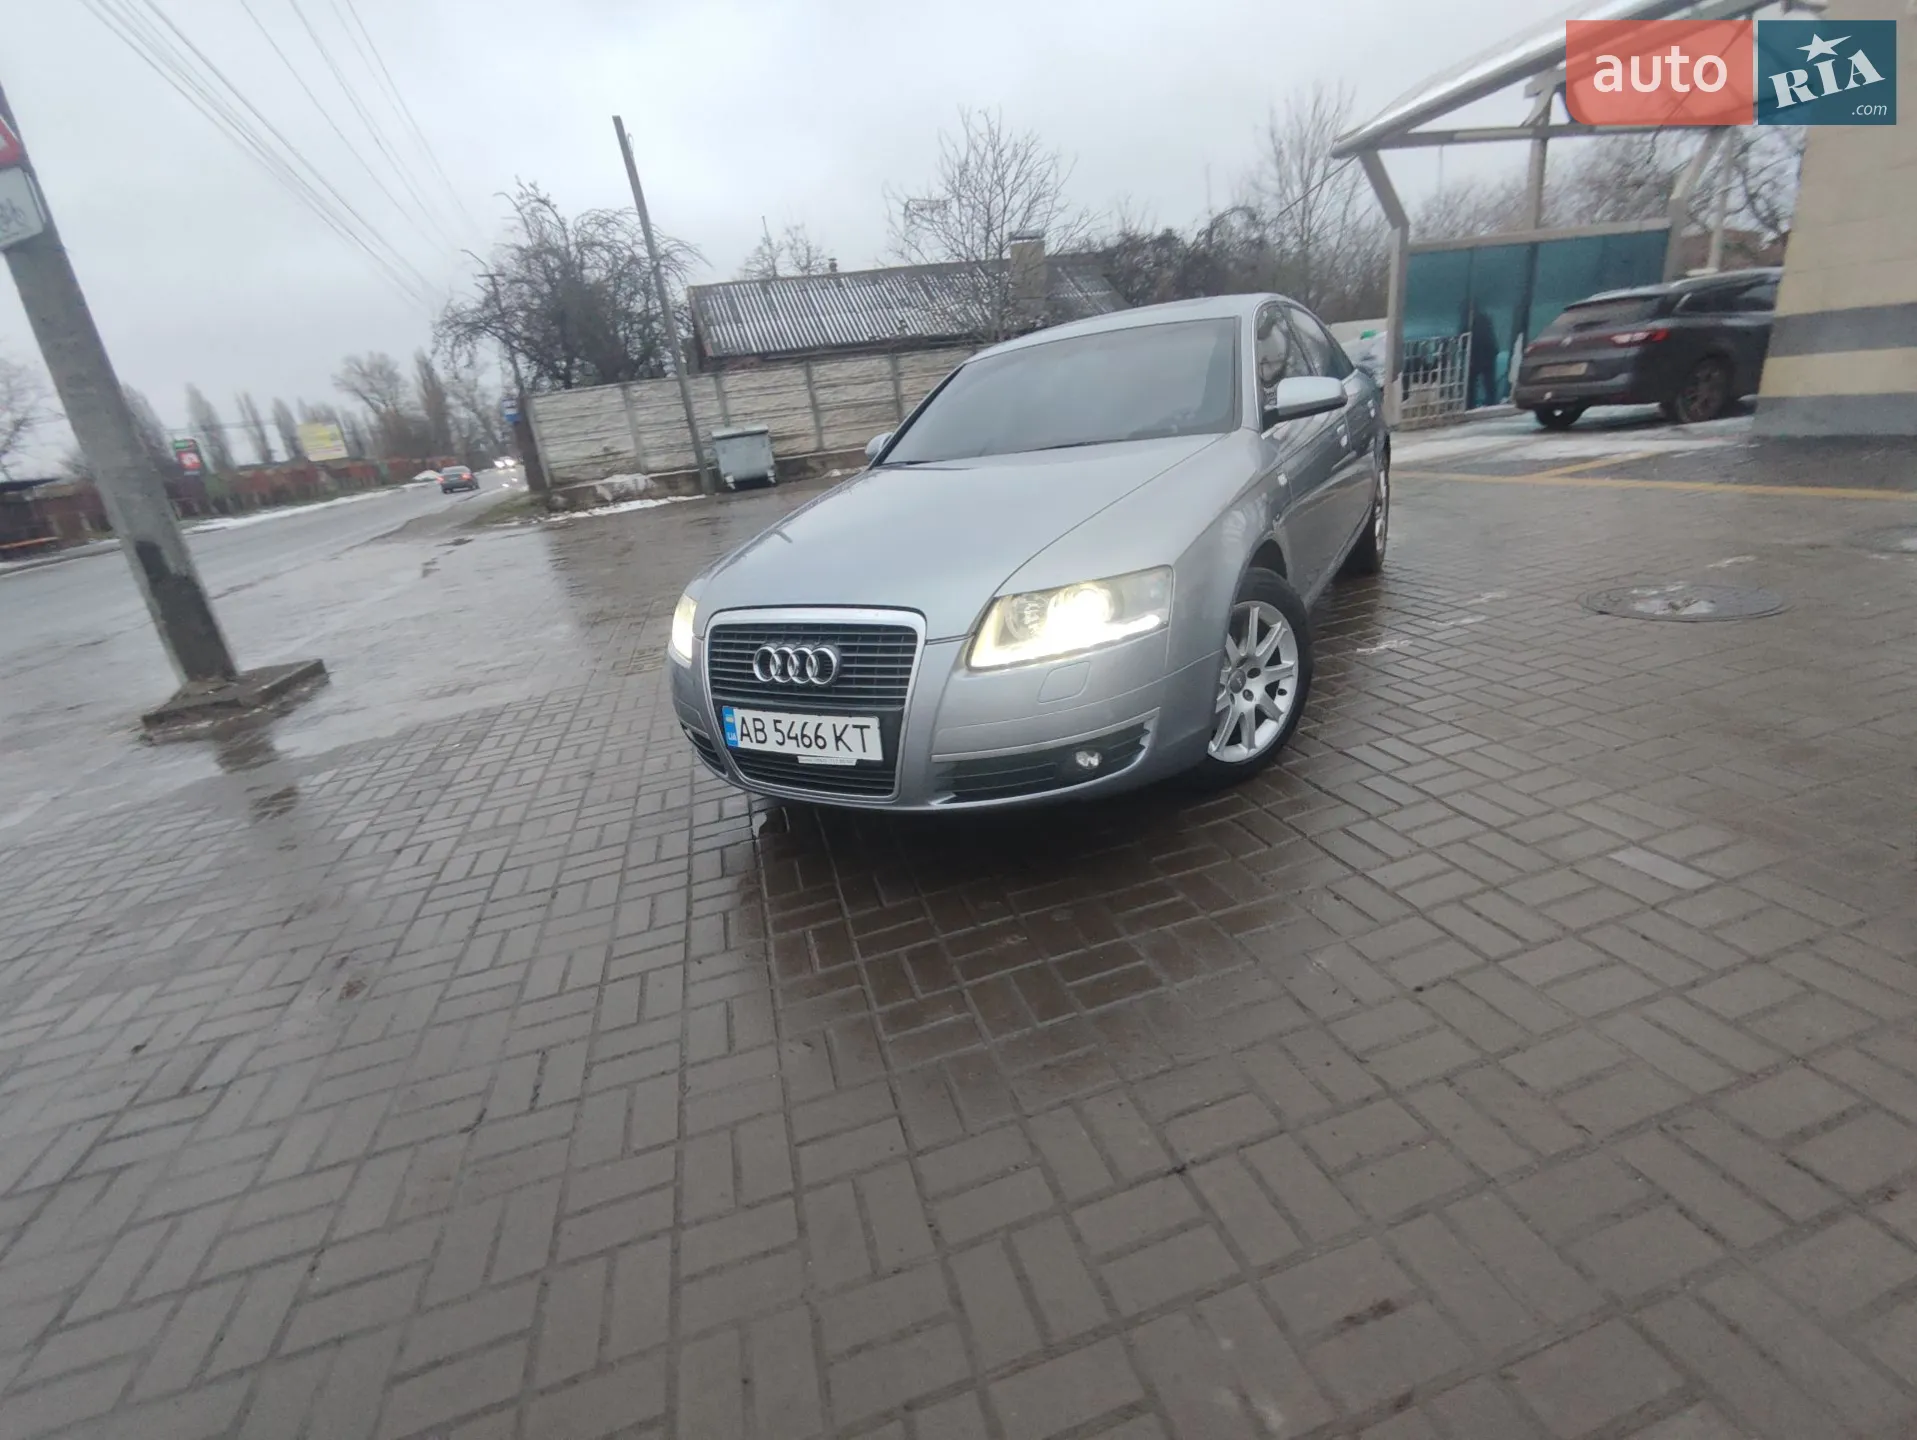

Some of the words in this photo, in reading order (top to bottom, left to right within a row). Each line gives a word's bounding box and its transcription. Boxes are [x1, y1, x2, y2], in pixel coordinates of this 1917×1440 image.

[740, 716, 767, 744] AB
[773, 719, 827, 750] 5466
[832, 723, 871, 753] KT
